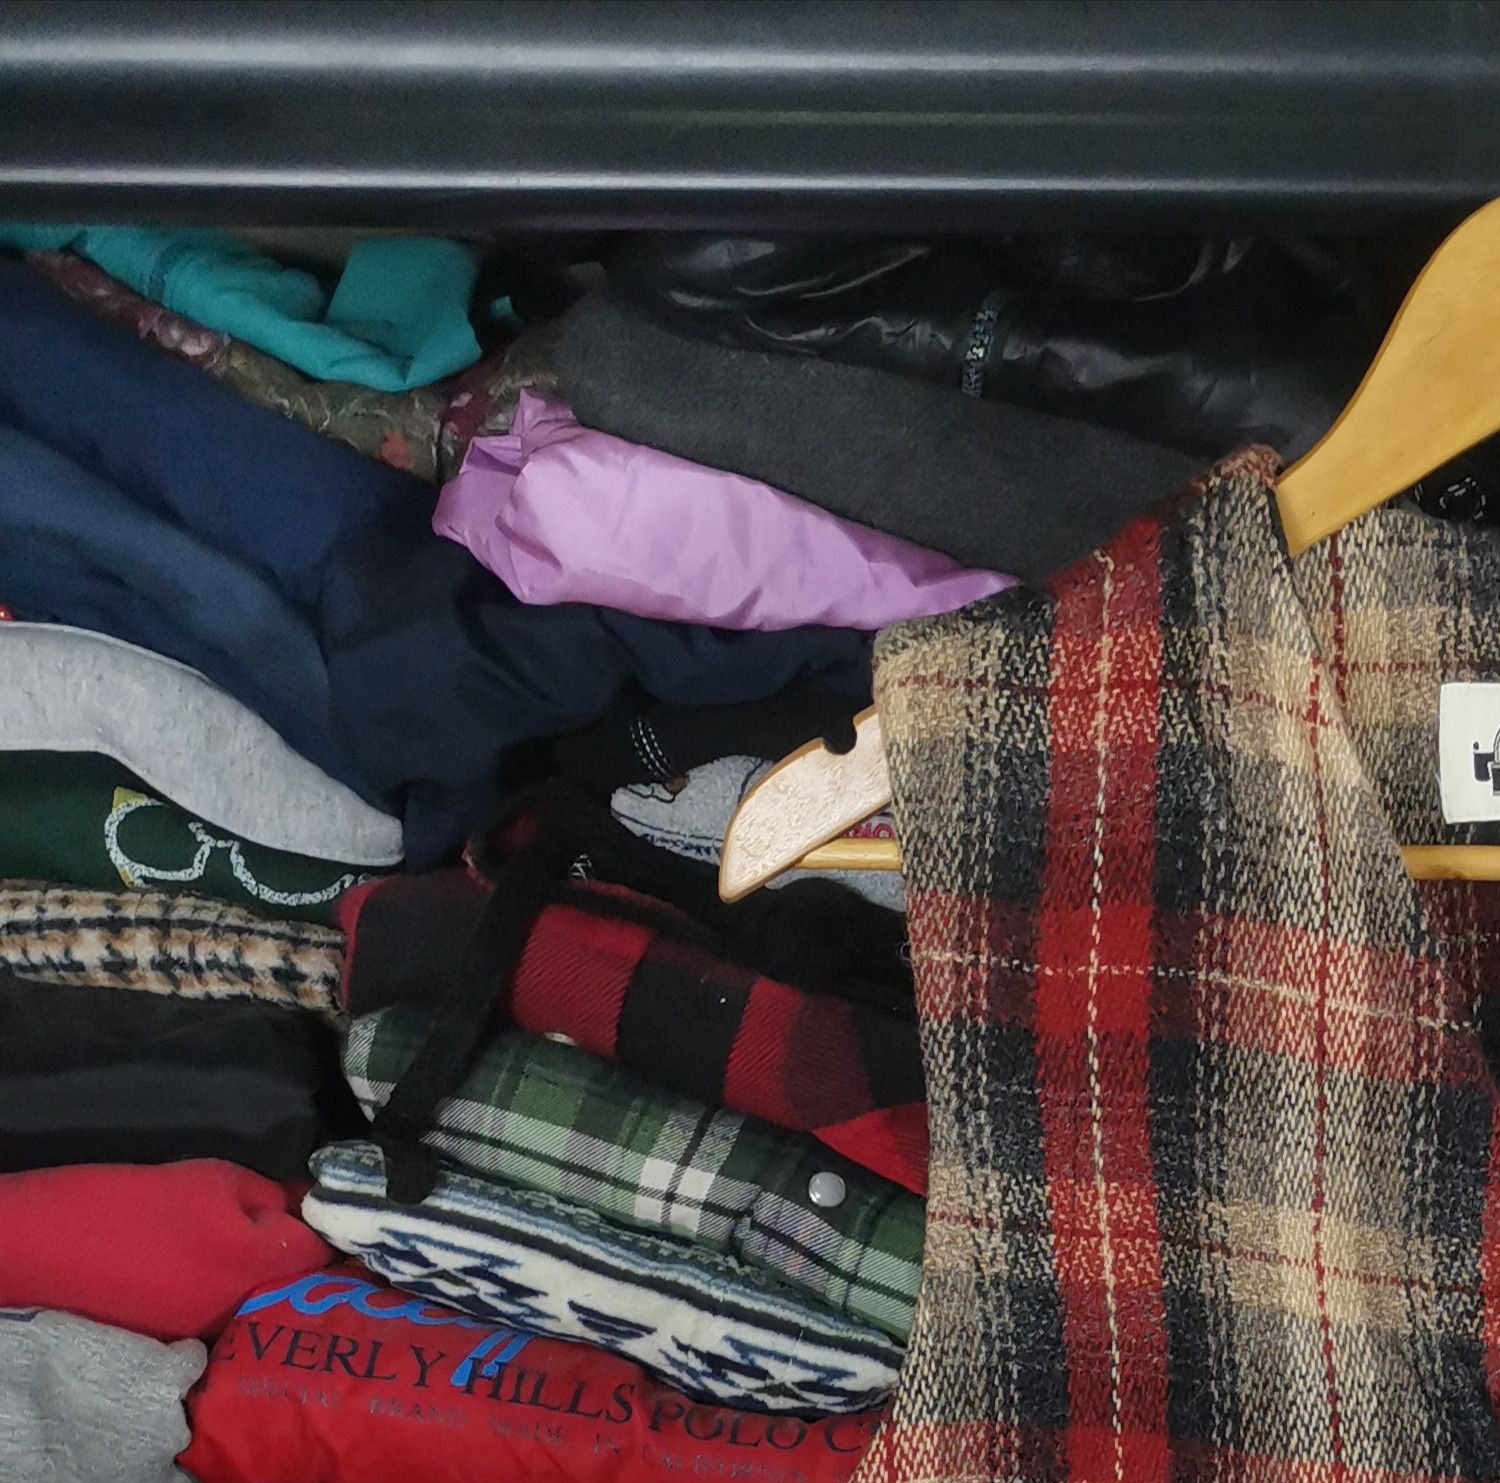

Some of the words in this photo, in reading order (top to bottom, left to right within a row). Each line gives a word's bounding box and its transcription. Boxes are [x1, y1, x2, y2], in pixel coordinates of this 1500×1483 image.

[368, 1396, 468, 1428] BRAND
[460, 1356, 636, 1424] HILLS
[647, 1399, 808, 1450] POLO
[823, 1417, 879, 1453] C
